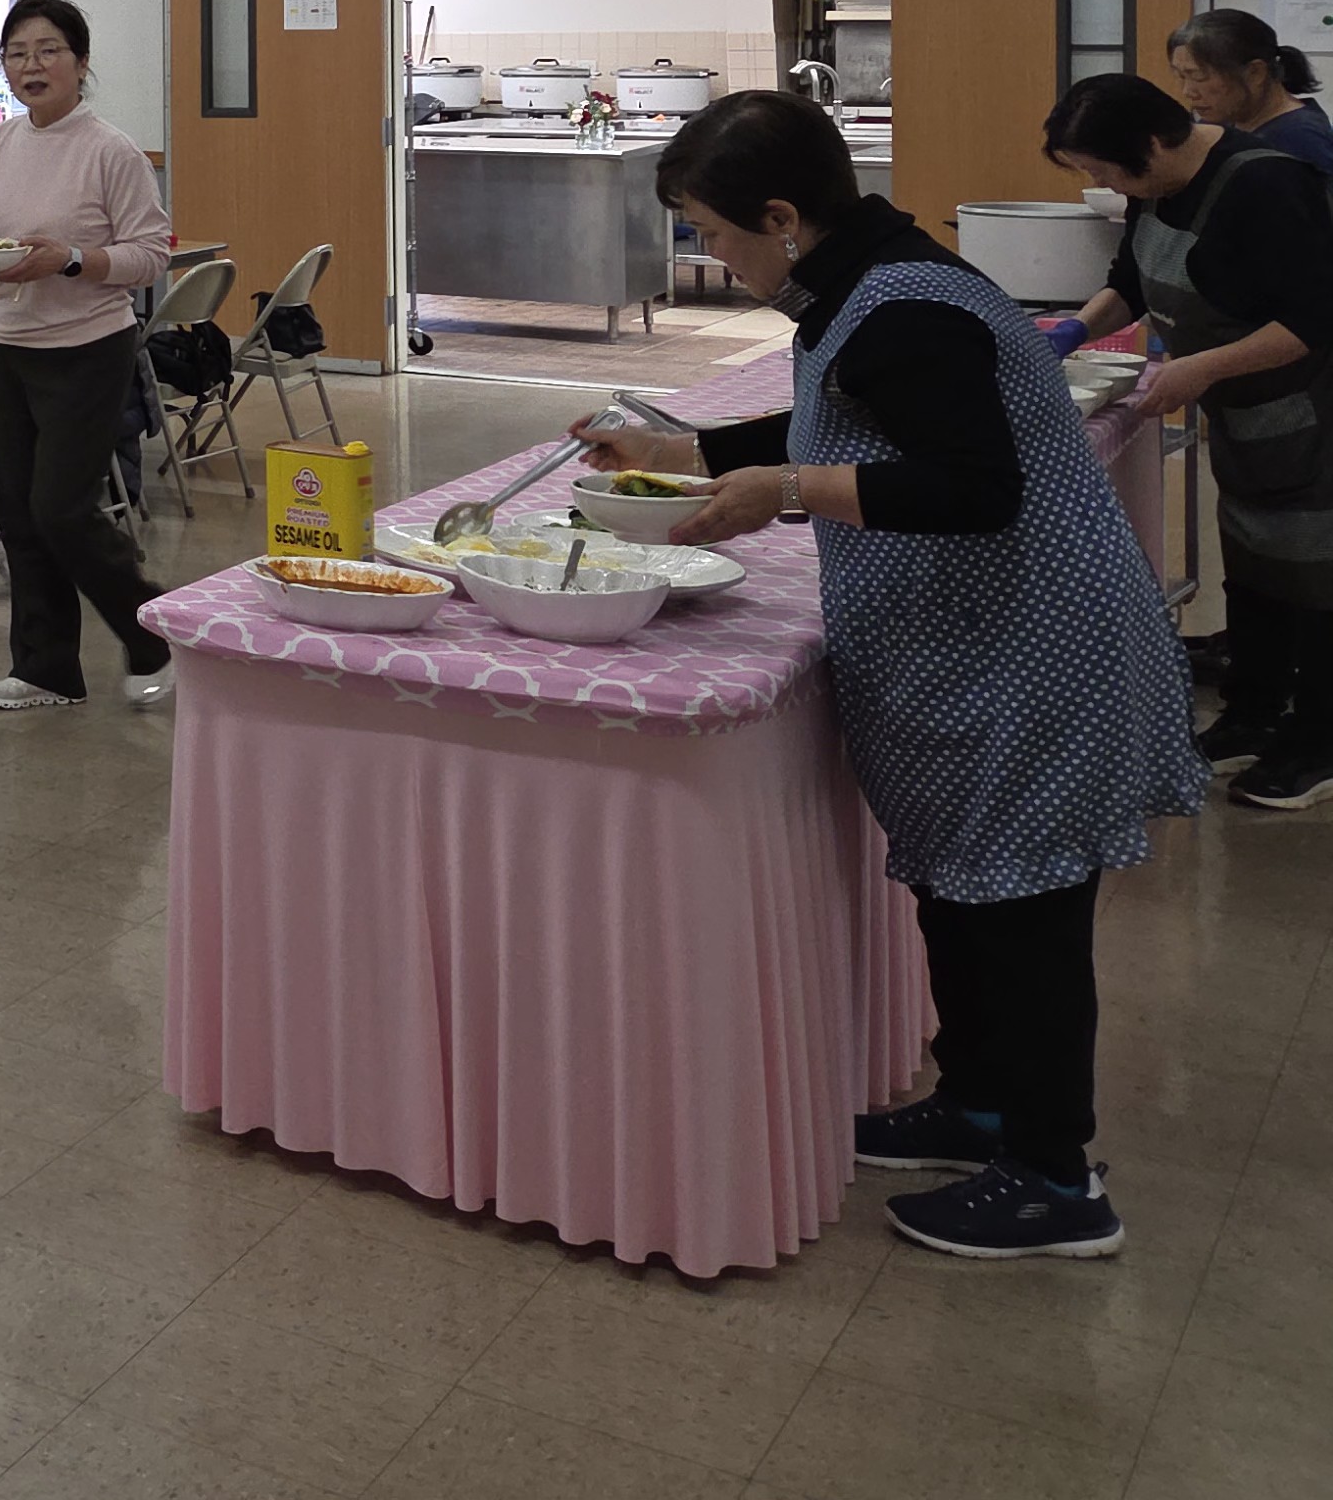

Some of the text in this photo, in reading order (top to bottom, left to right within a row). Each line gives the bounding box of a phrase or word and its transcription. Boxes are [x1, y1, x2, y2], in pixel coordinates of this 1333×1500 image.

[286, 508, 329, 518] PREMIUM
[286, 516, 329, 527] ROASTED
[275, 524, 343, 552] SESAME OIL
